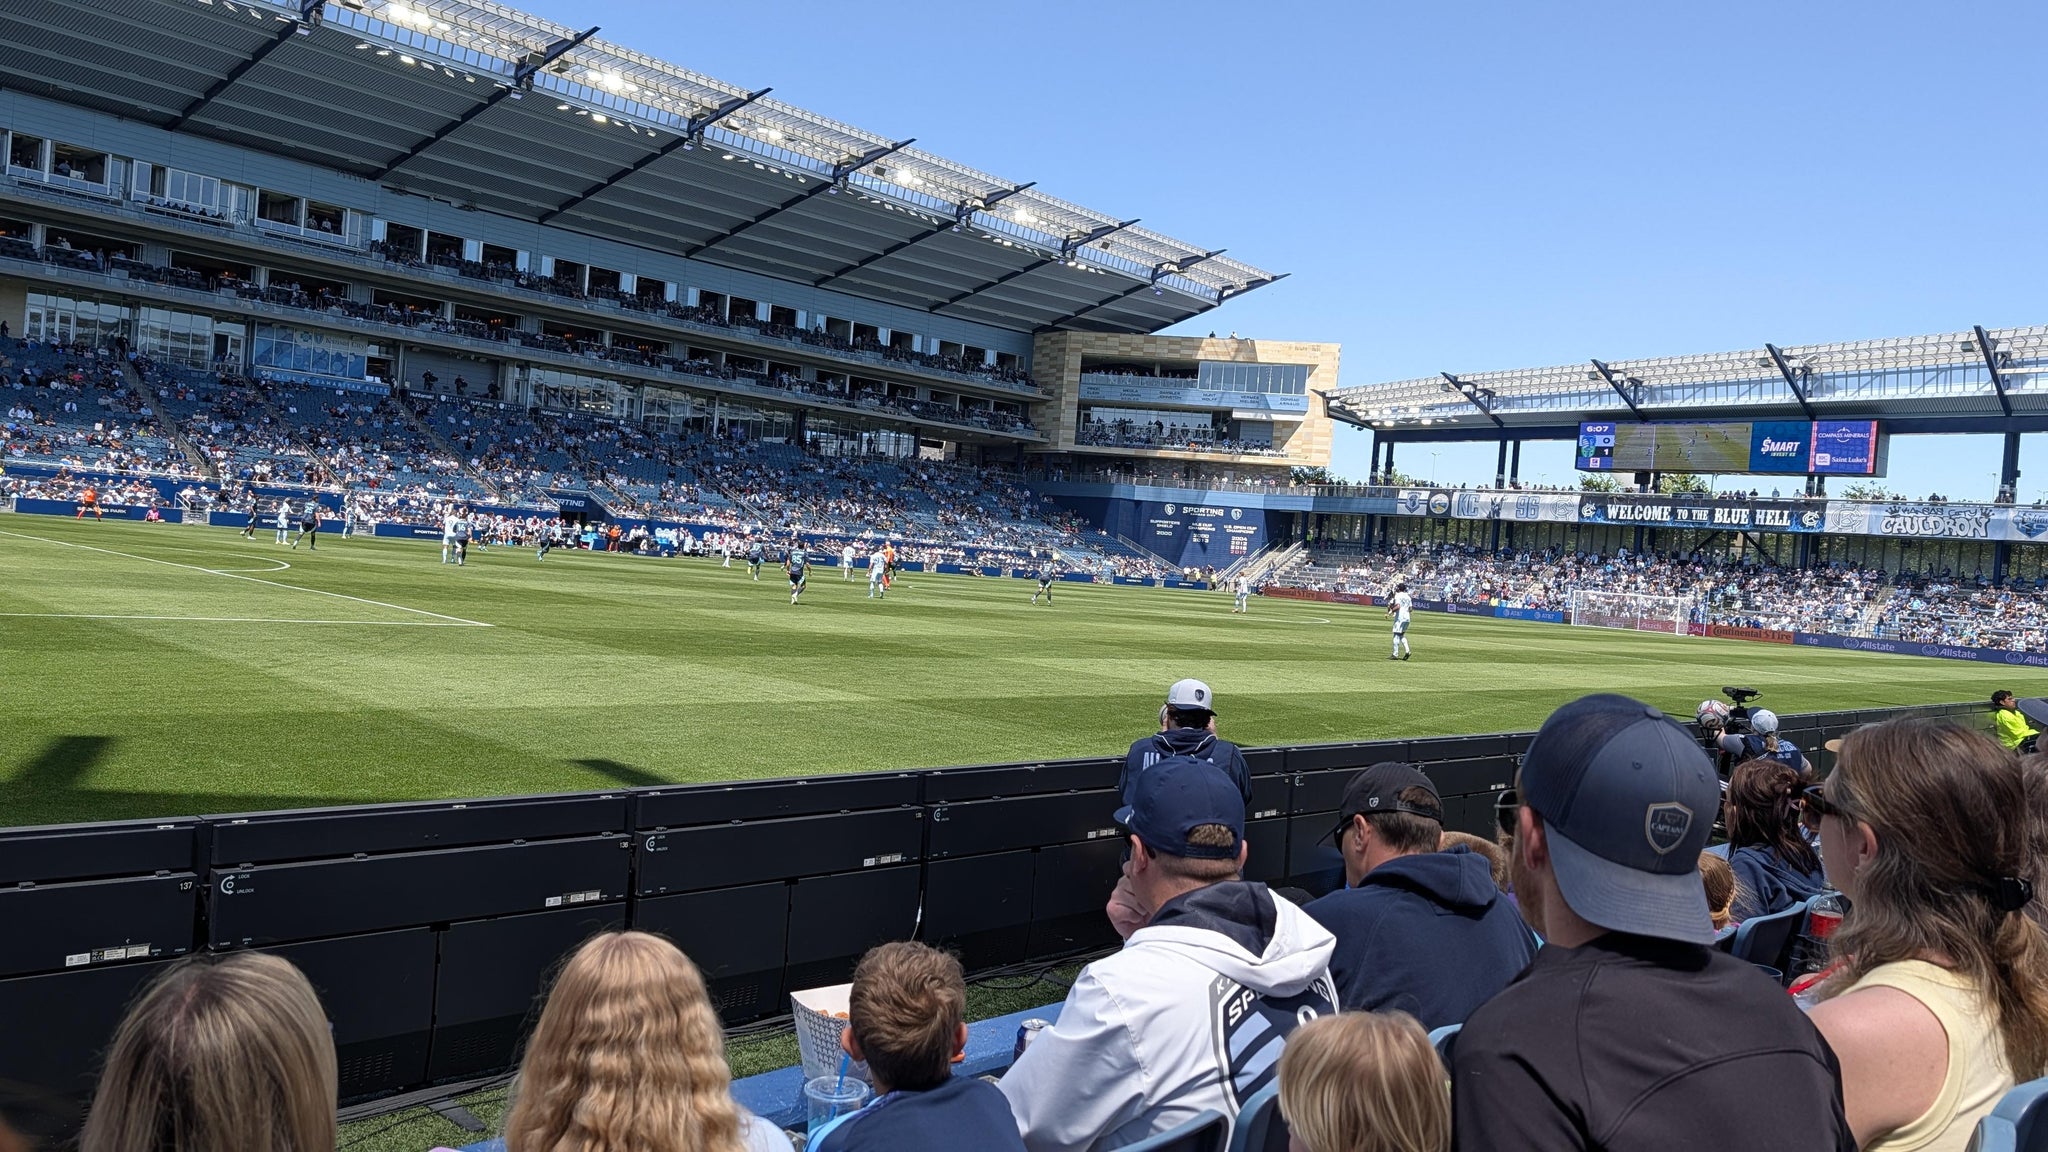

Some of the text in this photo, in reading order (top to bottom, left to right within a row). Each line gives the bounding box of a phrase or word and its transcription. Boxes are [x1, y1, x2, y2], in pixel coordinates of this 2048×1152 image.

[1586, 425, 1609, 433] 6:07
[1603, 448, 1609, 456] 1
[1456, 494, 1480, 517] KC
[1515, 495, 1540, 519] 96
[1182, 506, 1225, 516] SPORTING
[1607, 503, 1791, 526] WELCOME TO THE BLUE HELL
[458, 524, 466, 532] 16
[1880, 515, 1990, 538] CAULDRON
[791, 555, 803, 564] 85
[1640, 621, 1662, 630] Audi
[1713, 626, 1792, 641] Continental Tire
[1860, 641, 1896, 652] Allstate
[1939, 648, 1978, 659] Allstate
[179, 881, 193, 891] 137
